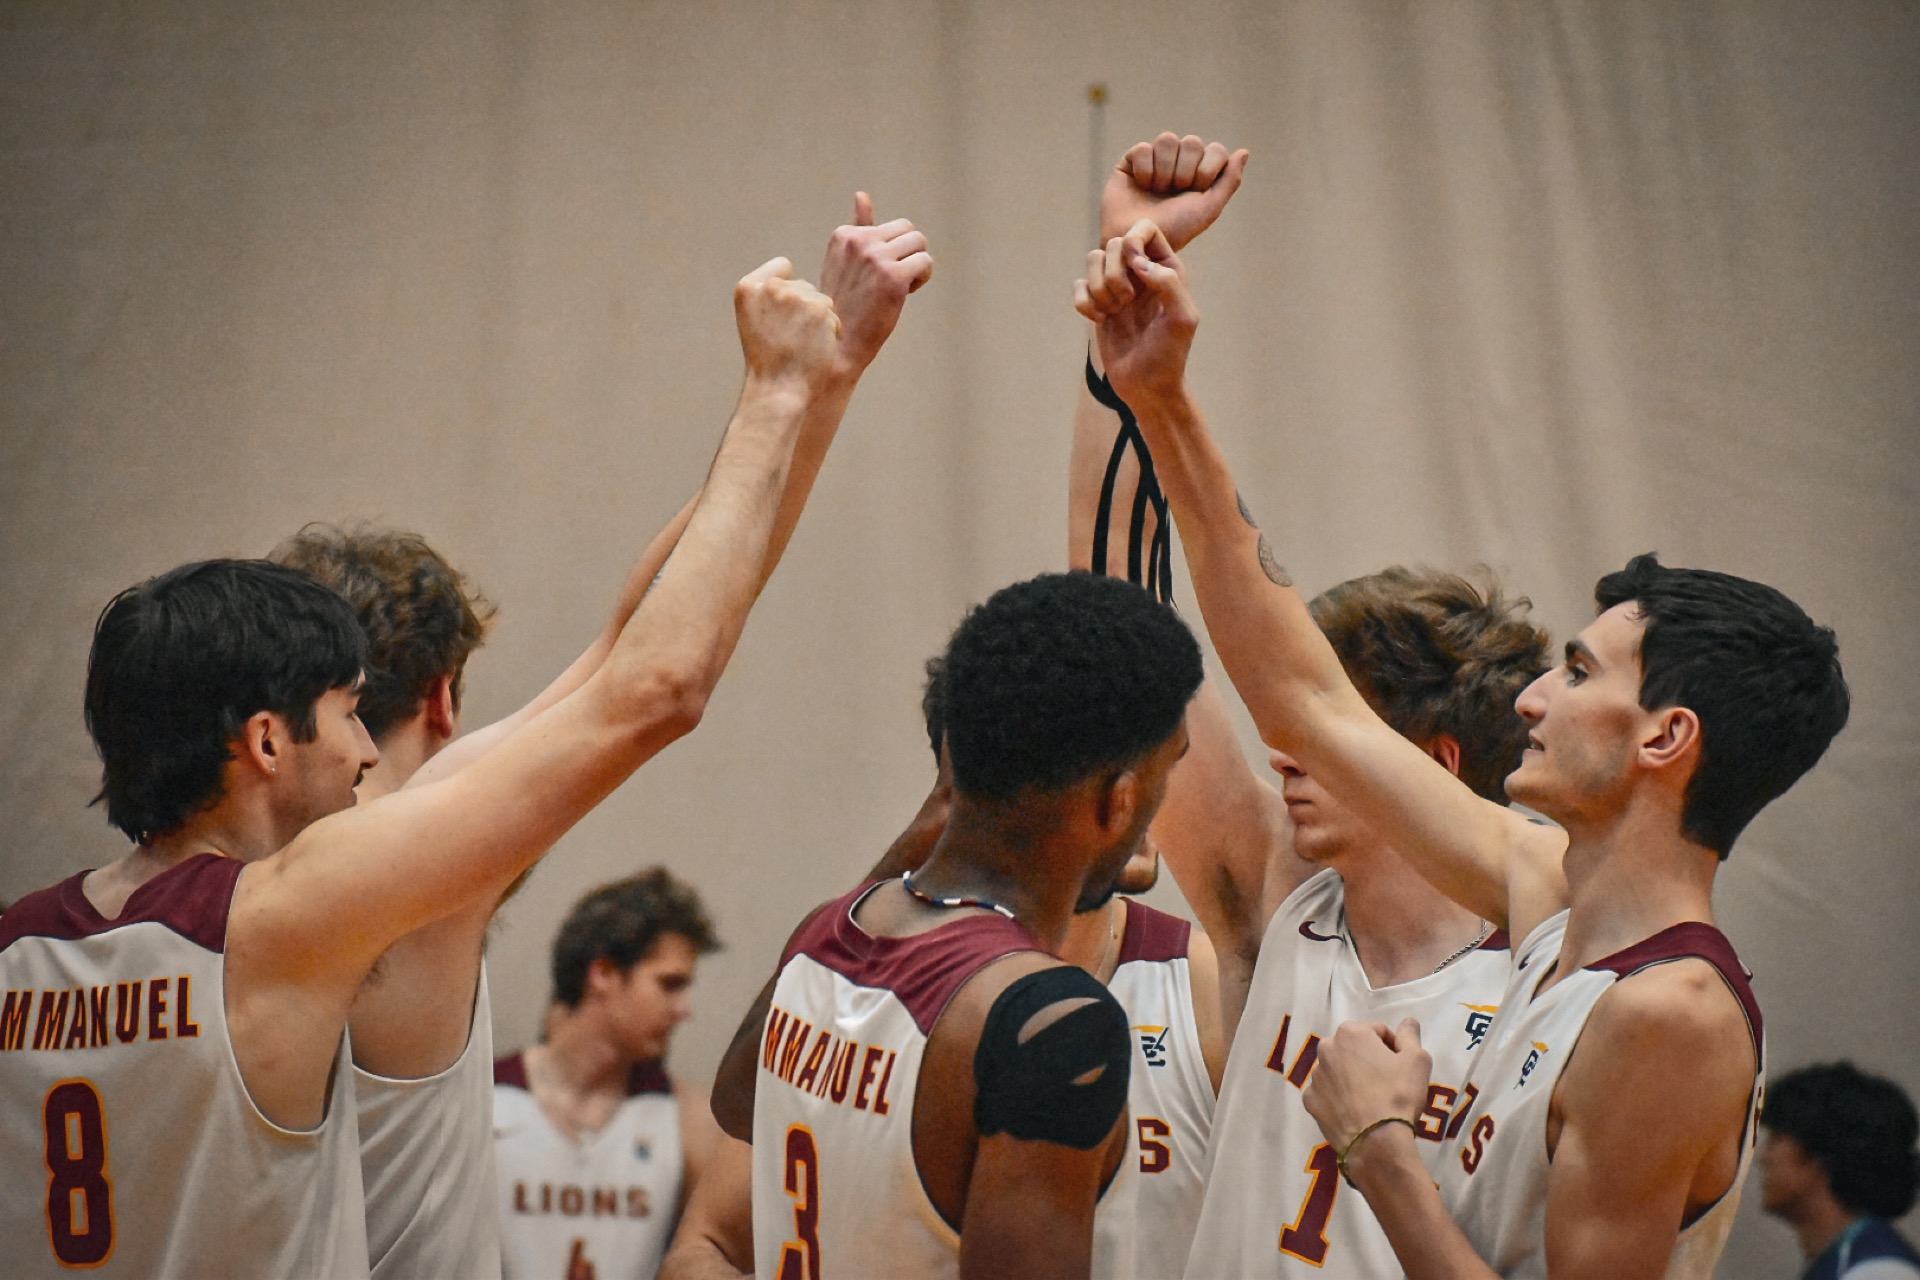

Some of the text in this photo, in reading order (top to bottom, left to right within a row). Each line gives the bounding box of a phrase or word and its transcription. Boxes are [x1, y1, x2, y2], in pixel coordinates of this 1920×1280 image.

[1265, 1013, 1460, 1142] LIS
[42, 1077, 116, 1269] 8
[514, 1180, 650, 1217] LIONS
[774, 1122, 821, 1280] 3
[1278, 1141, 1341, 1268] 1
